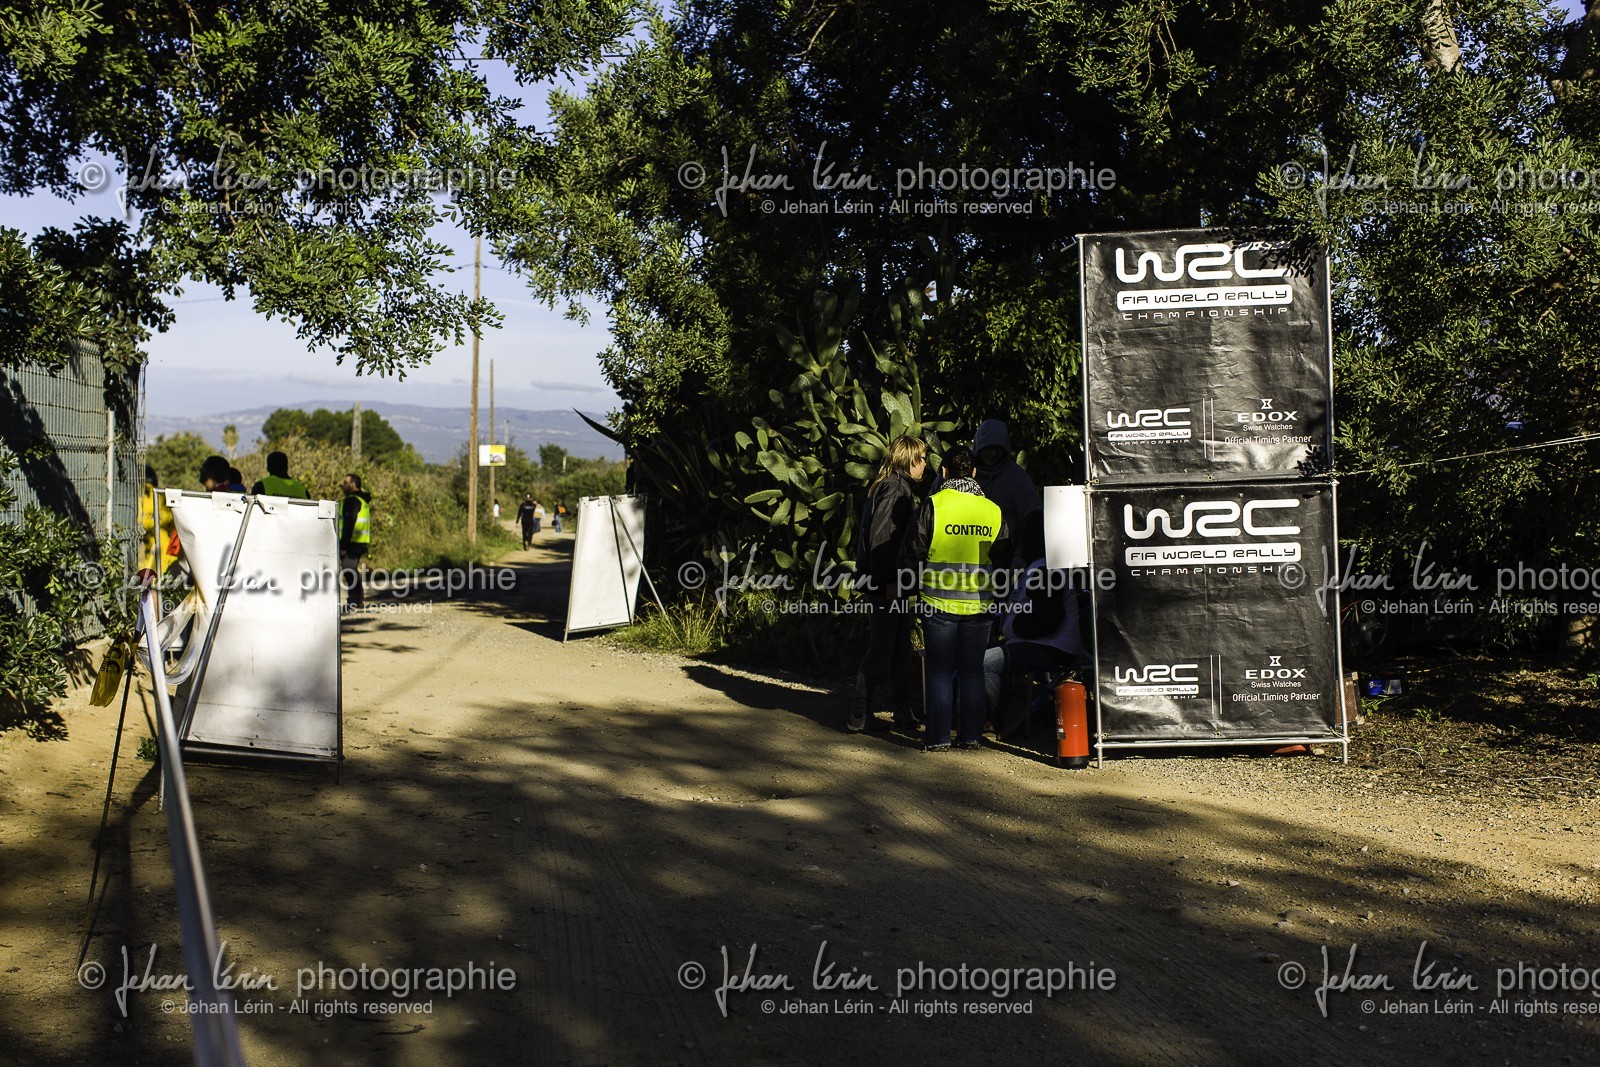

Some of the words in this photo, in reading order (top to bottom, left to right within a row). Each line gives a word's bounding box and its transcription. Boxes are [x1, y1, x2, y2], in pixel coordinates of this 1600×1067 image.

[1116, 242, 1291, 284] WRC
[1122, 295, 1149, 304] FIA
[1154, 292, 1219, 304] WORLD
[1224, 290, 1288, 300] RALLY
[1122, 307, 1288, 321] CHAMPIONSHIP
[1106, 408, 1192, 428] WRC
[1237, 410, 1298, 422] EDOX
[1242, 424, 1262, 432] Swiss
[1224, 436, 1252, 444] Official
[1254, 436, 1280, 444] Timing
[1282, 434, 1312, 443] Partner
[1124, 498, 1301, 540] WRC
[944, 524, 992, 538] CONTROL
[1130, 552, 1157, 561] FIA
[1162, 550, 1227, 560] WORLD
[1233, 548, 1296, 558] RALLY
[1130, 565, 1296, 577] CHAMPIONSHIP
[1114, 664, 1199, 684] WRC
[1245, 668, 1306, 680] EDOX
[1272, 680, 1302, 688] Watches
[1232, 693, 1261, 702] Official
[1262, 692, 1289, 702] Timing
[1290, 692, 1321, 701] Partner
